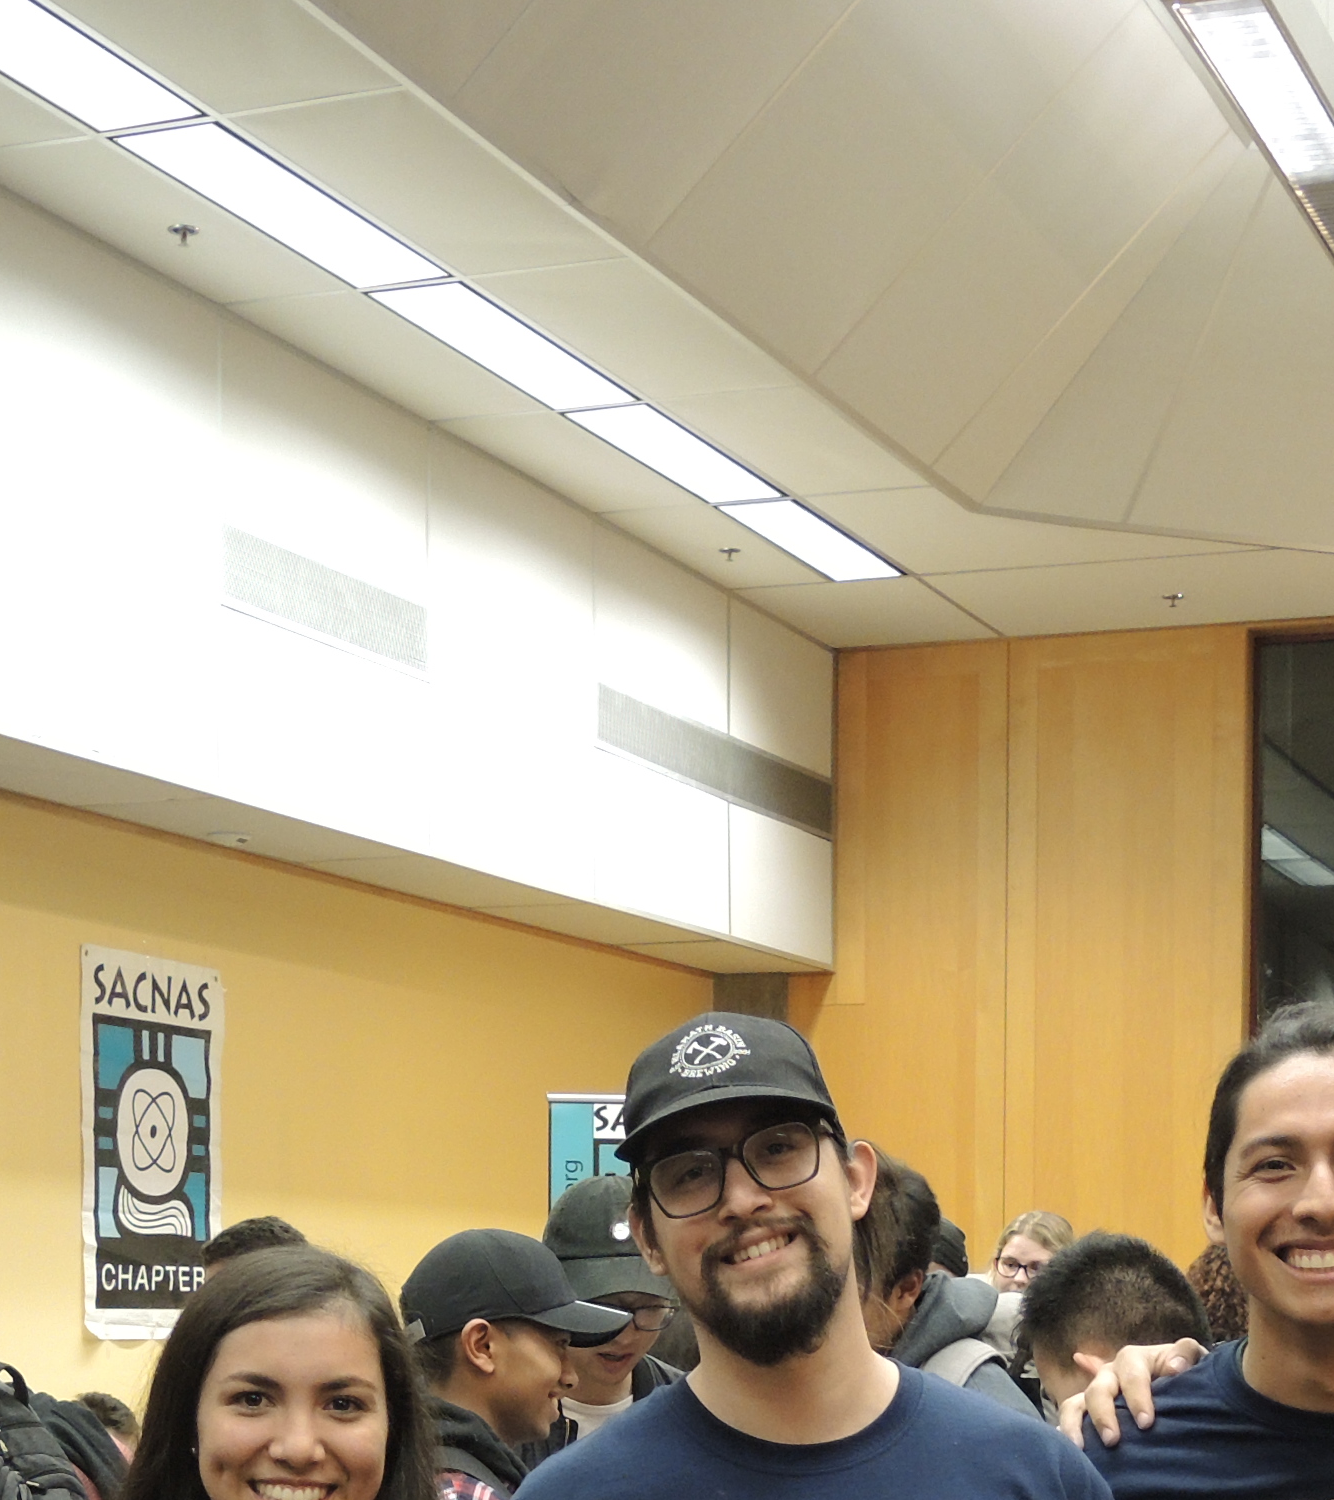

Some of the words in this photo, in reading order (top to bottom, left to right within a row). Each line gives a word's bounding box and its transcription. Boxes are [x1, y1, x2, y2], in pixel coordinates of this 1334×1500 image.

[93, 963, 210, 1022] SACNAS
[715, 1025, 746, 1048] BASIN
[680, 1058, 737, 1077] BREWING
[101, 1263, 205, 1292] CHAPTER
